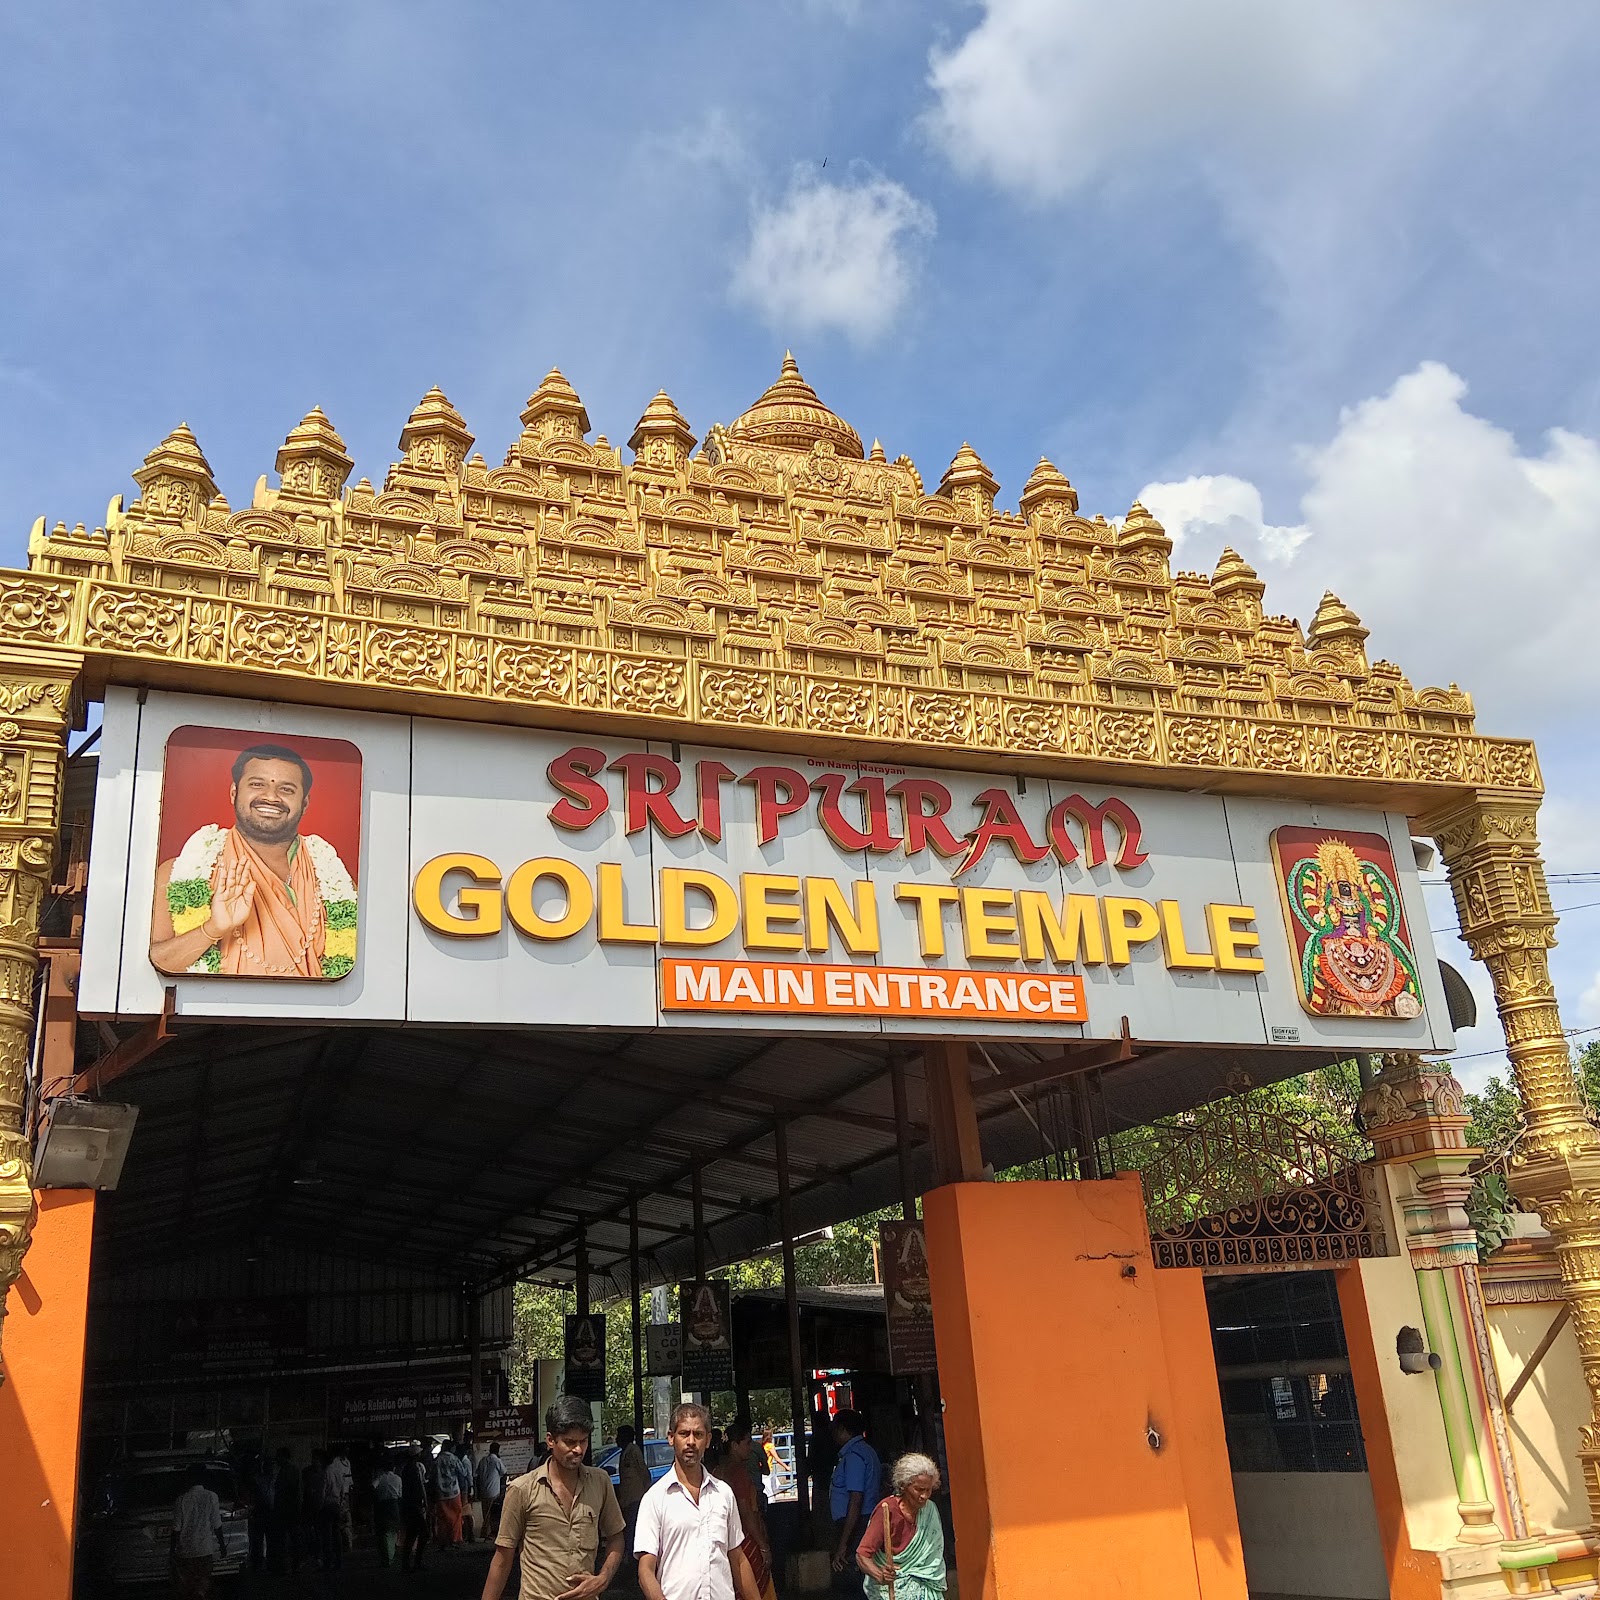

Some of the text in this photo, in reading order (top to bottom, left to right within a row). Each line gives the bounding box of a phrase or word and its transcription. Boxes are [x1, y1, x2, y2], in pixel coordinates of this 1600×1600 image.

[807, 759, 906, 776] Om Namo Narayani
[547, 746, 1150, 879] SRIPURAM
[412, 853, 1265, 974] GOLDEN TEMPLE
[674, 965, 1078, 1014] MAIN ENTRANCE
[345, 1396, 418, 1413] Public Relation Office
[488, 1408, 519, 1418] SEVA
[484, 1418, 524, 1429] ENTRY
